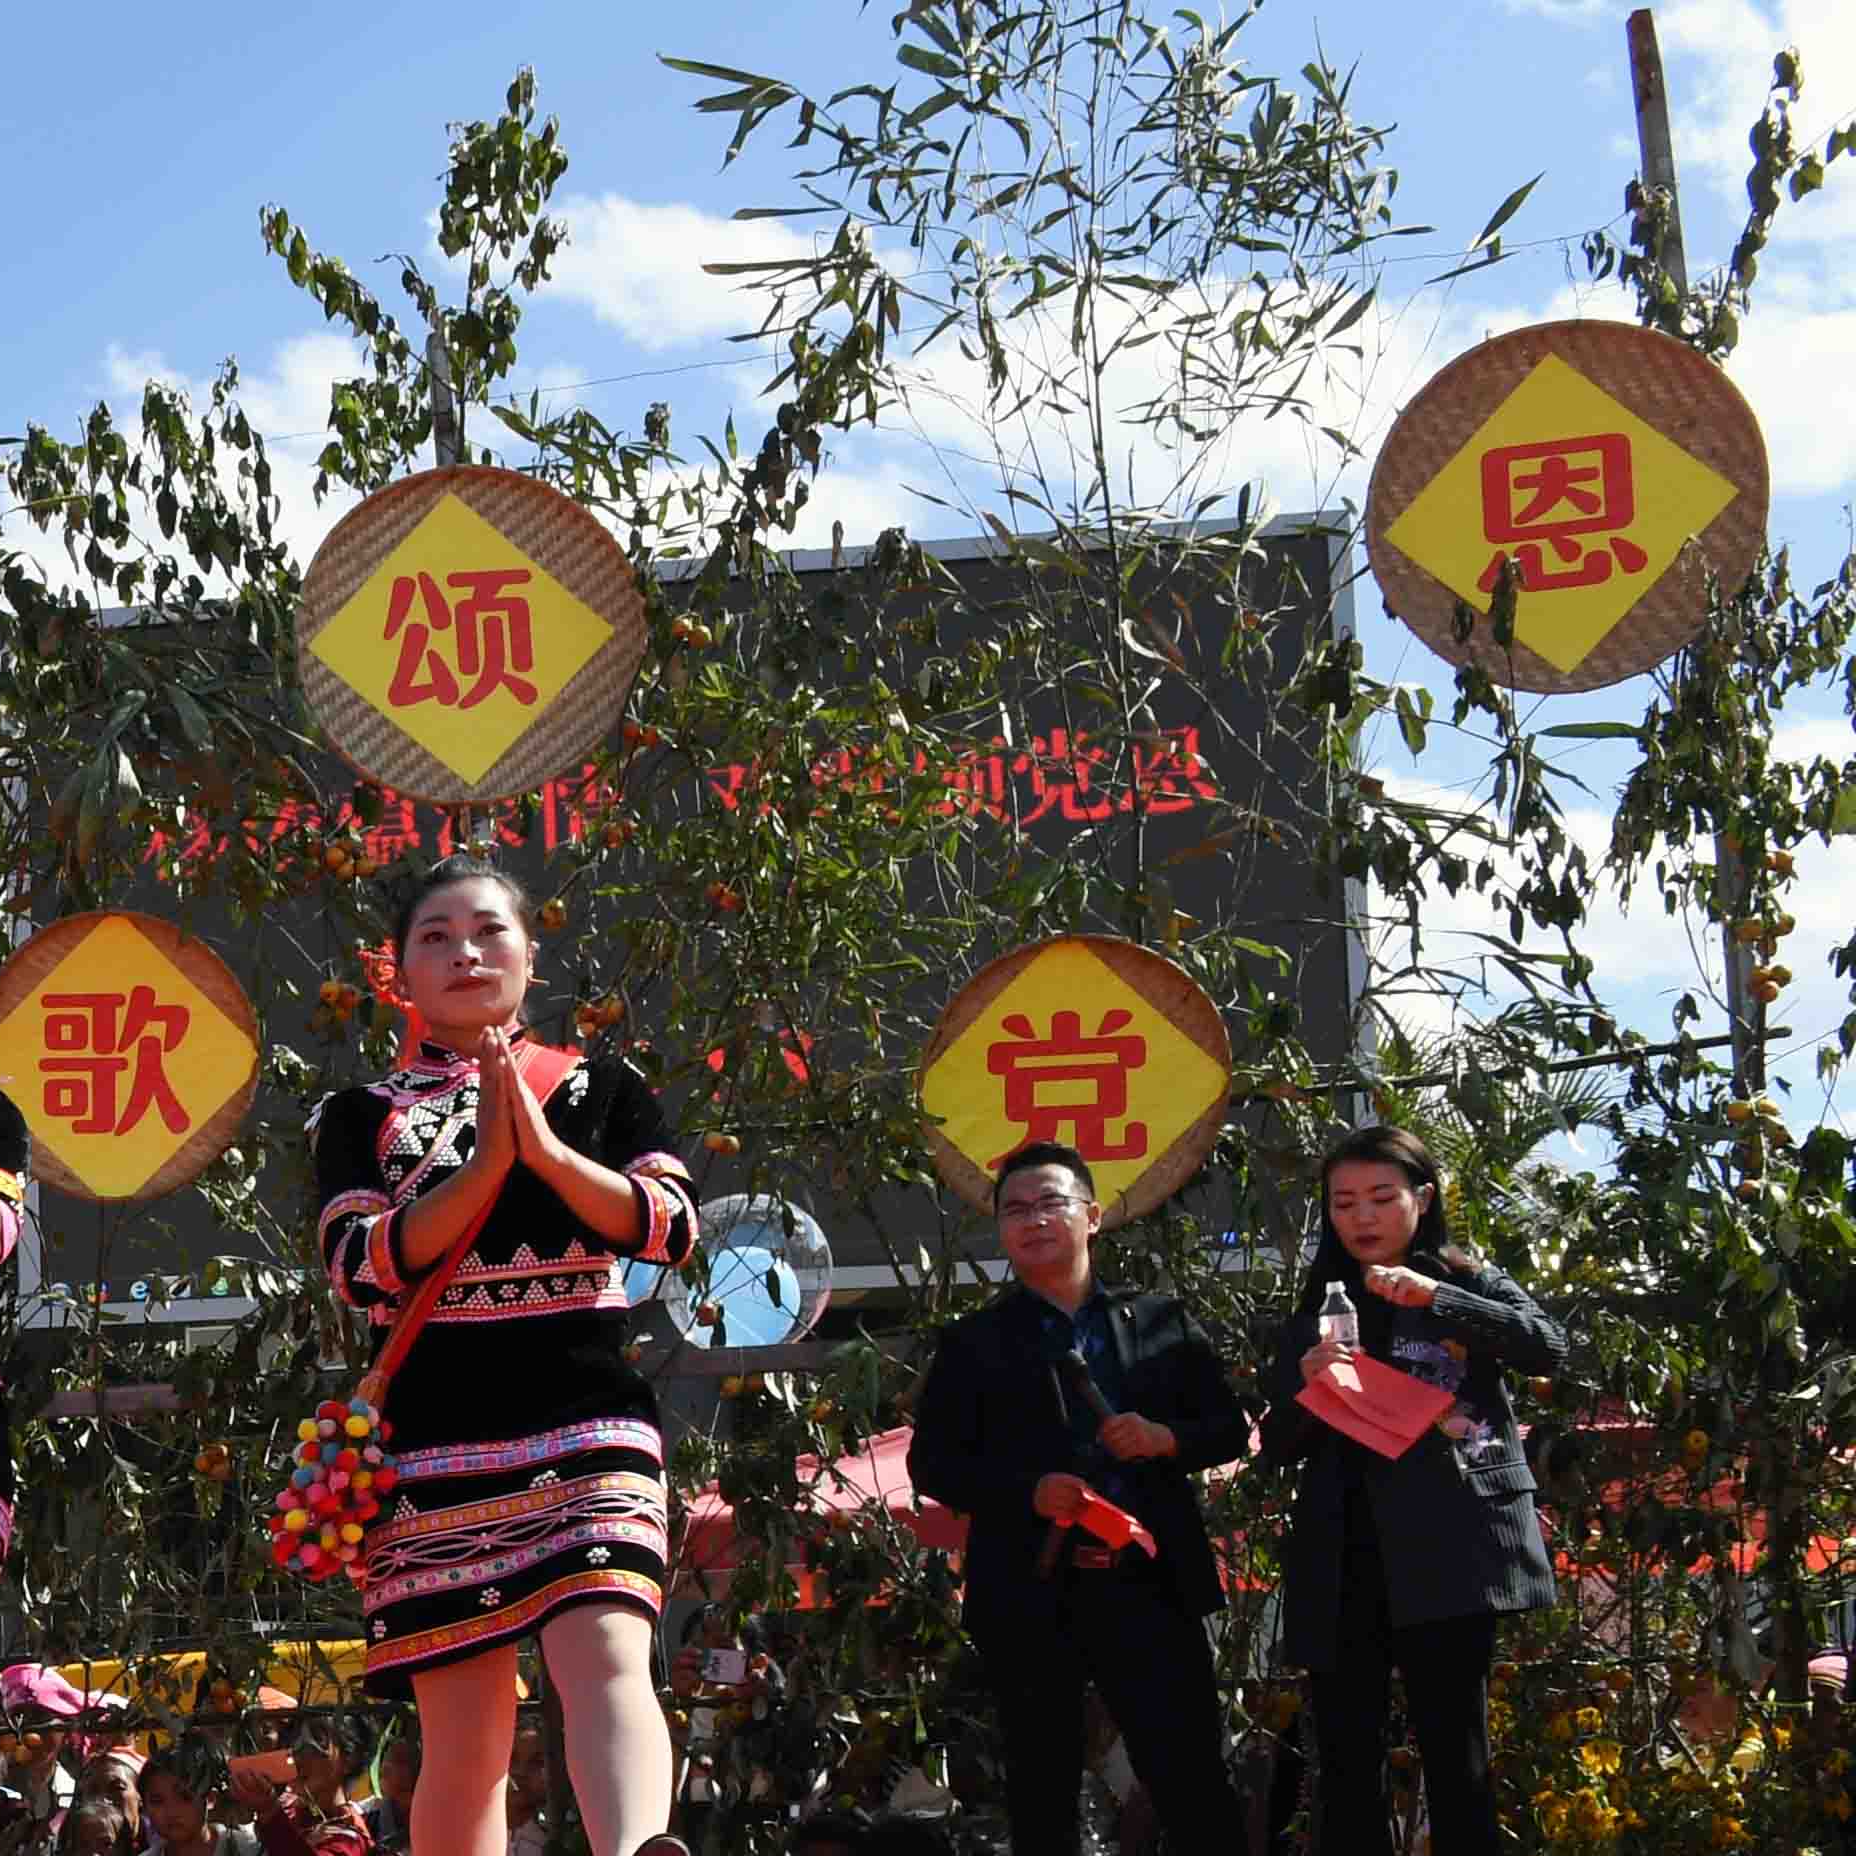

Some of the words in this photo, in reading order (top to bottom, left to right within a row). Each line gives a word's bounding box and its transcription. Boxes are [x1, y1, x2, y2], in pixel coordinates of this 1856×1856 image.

[1477, 433, 1649, 594] 恩
[383, 567, 536, 711] 颂
[39, 984, 191, 1136] 歌
[986, 1008, 1147, 1170] 党
